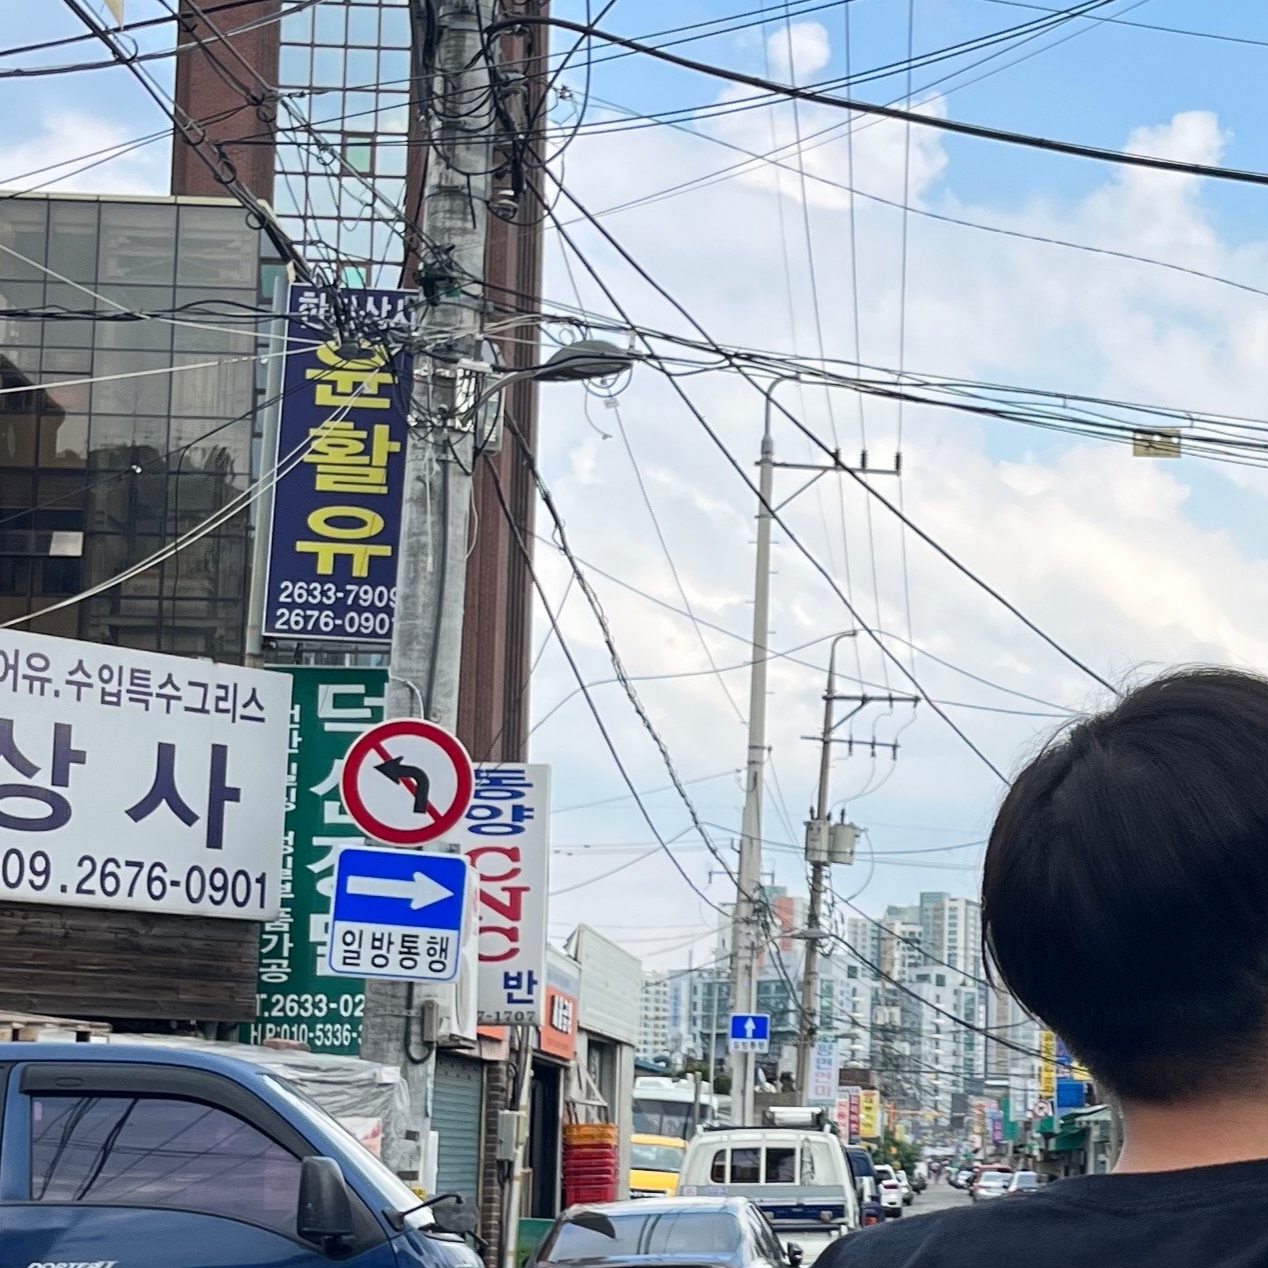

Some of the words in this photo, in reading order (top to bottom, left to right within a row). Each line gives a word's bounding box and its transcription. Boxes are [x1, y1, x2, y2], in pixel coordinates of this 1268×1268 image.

[295, 339, 401, 578] 윤활유
[274, 608, 396, 635] 2676-090
[342, 930, 450, 973] 일방통행
